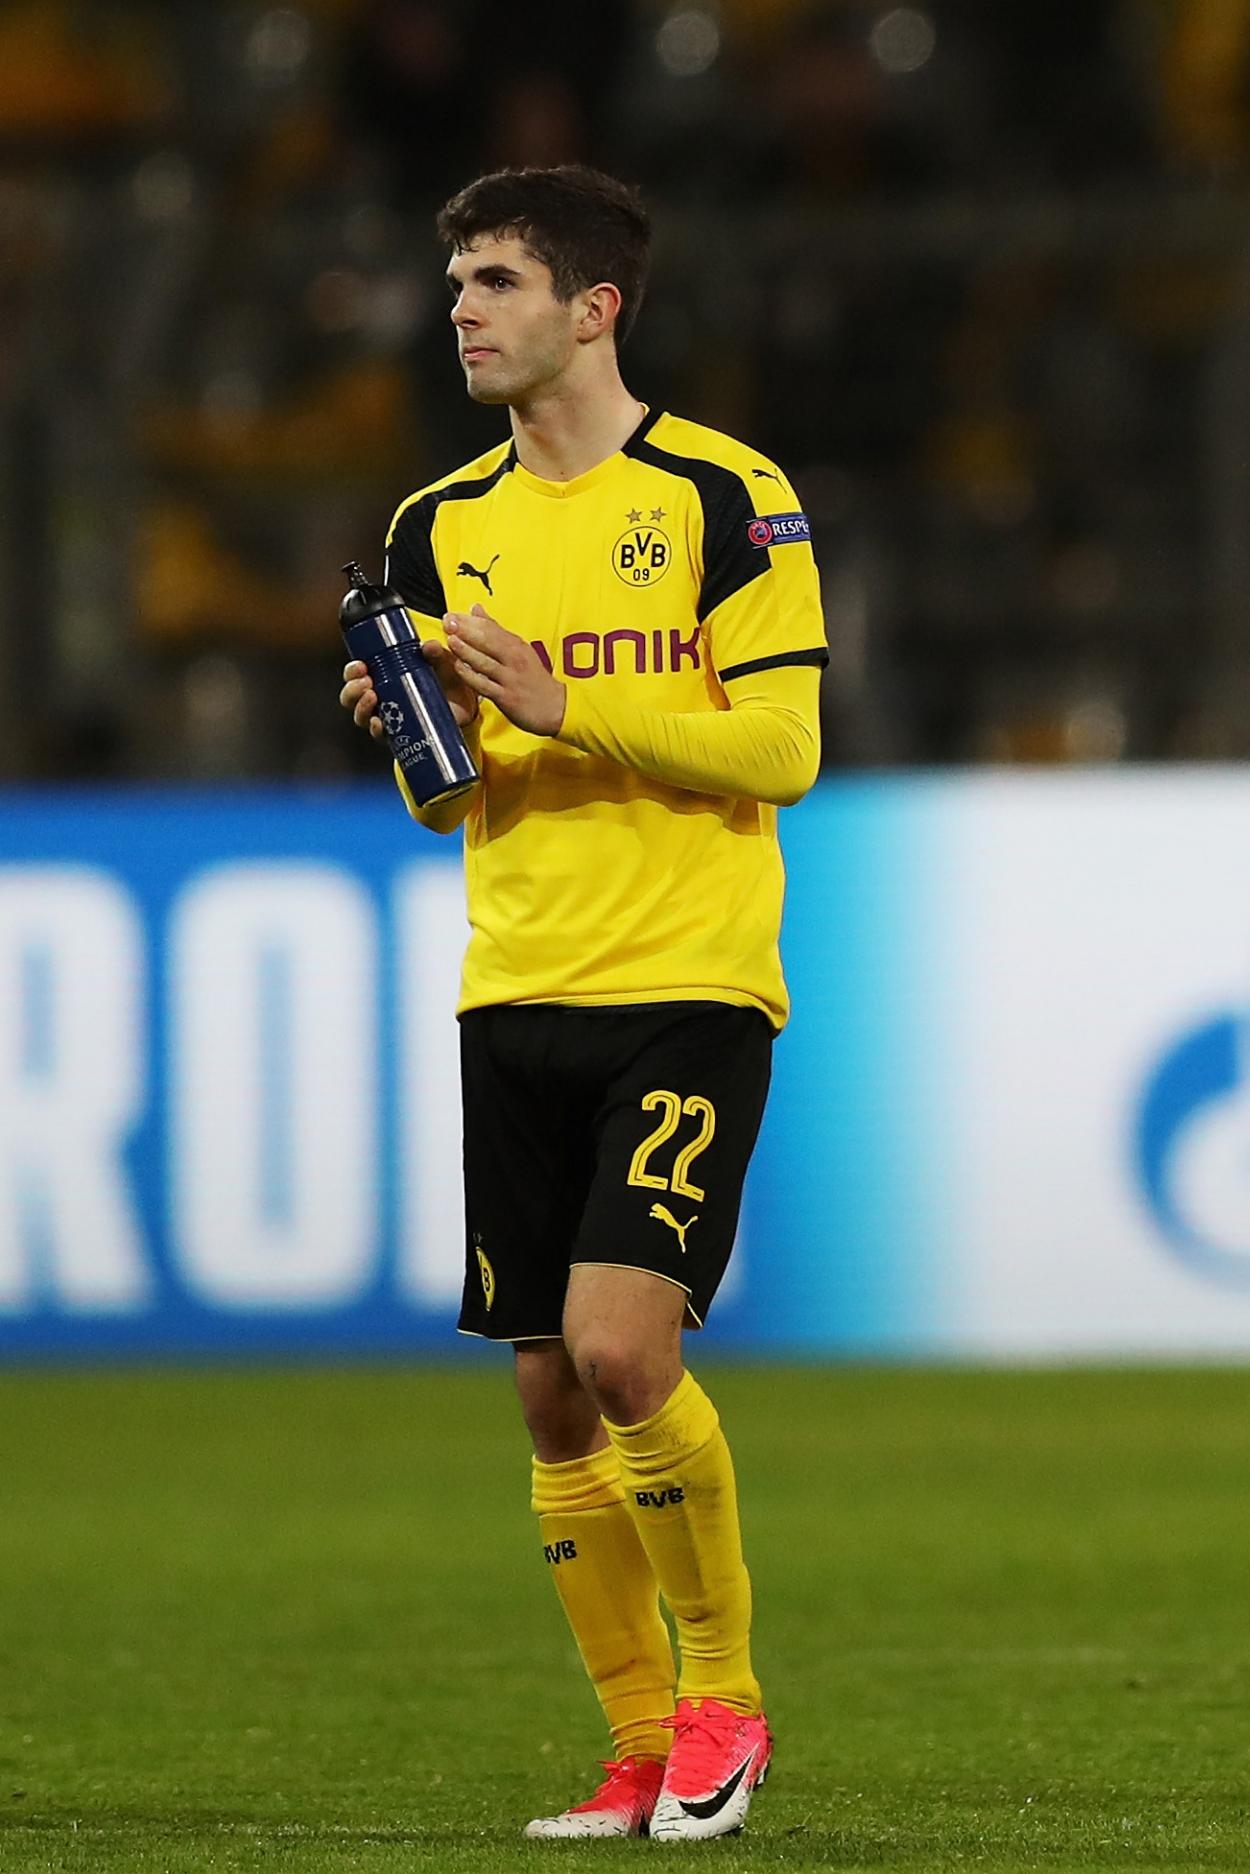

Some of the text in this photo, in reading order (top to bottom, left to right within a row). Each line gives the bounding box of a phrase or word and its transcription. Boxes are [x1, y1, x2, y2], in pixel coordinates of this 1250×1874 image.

[620, 532, 667, 569] BVB
[633, 568, 650, 581] 09
[627, 1089, 716, 1203] 22
[635, 1487, 686, 1508] BVB
